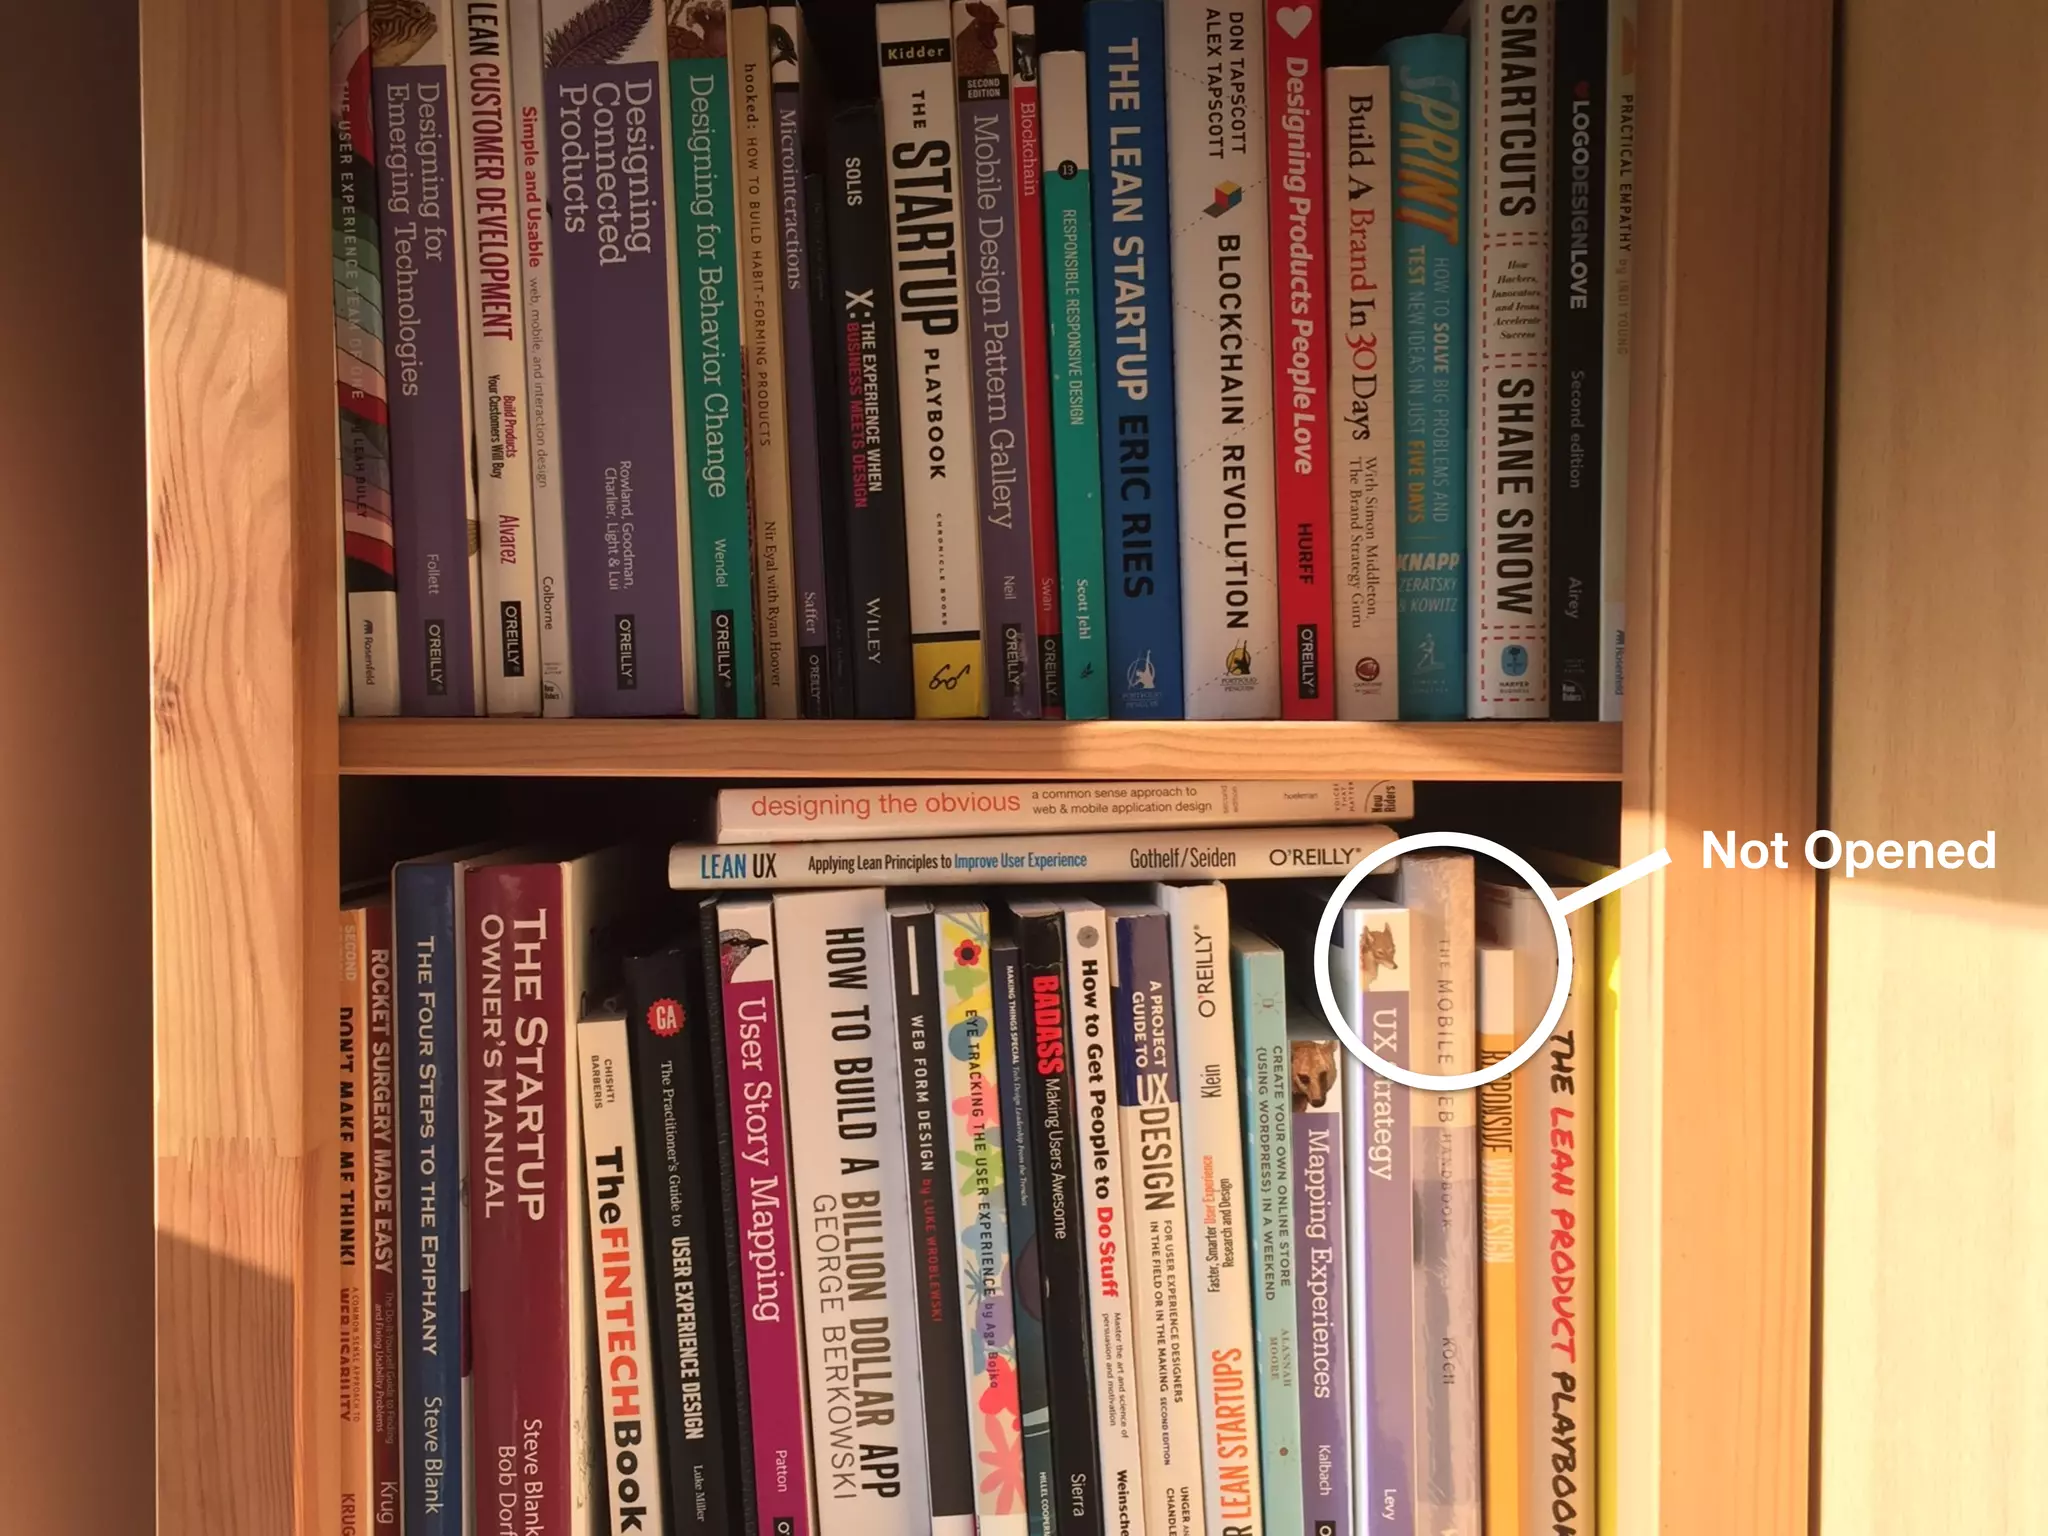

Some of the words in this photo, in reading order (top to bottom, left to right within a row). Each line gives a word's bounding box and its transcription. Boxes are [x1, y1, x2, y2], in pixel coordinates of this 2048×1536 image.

[468, 3, 499, 56] LEAN
[745, 64, 758, 130] hooked:
[967, 80, 999, 88] SECOND
[968, 90, 1000, 98] EDITION
[1108, 38, 1140, 111] THE
[469, 63, 503, 179] CUSTOMER
[521, 107, 537, 166] Simple
[1282, 57, 1311, 192] Designing
[1348, 95, 1374, 168] Build
[1499, 4, 1536, 216] SMARTCUTS
[386, 83, 411, 213] Emerging
[416, 83, 444, 218] Designing
[559, 84, 590, 233] Products
[592, 82, 626, 266] Connected
[622, 79, 656, 253] Designing
[688, 74, 719, 216] Designing
[747, 138, 759, 169] HOW
[973, 115, 1000, 210] Mobile
[1020, 103, 1037, 196] Blockchain
[1110, 127, 1144, 222] LEAN
[1395, 65, 1459, 245] SPRINT
[524, 172, 539, 202] and
[748, 177, 760, 194] TO
[780, 109, 804, 290] Microinteractions
[845, 158, 862, 207] SOLIS
[1349, 176, 1374, 200] A
[425, 227, 446, 261] for
[526, 207, 542, 267] Usable
[697, 224, 723, 259] for
[749, 202, 762, 244] BUILD
[1063, 210, 1078, 295] RESPONSIBLE
[1350, 209, 1377, 291] Brand
[476, 188, 512, 341] DEVELOPMENT
[976, 217, 1005, 315] Design
[1289, 197, 1313, 313] Products
[394, 222, 422, 396] Technologies
[699, 267, 726, 385] Behavior
[752, 251, 767, 366] HABIT-FORMING
[1066, 299, 1081, 376] RESPONSIVE
[1113, 235, 1148, 400] STARTUP
[1218, 235, 1243, 424] BLOCKCHAIN
[1350, 298, 1375, 328] In
[984, 322, 1010, 423] Pattern
[1286, 319, 1316, 408] People
[1345, 333, 1378, 370] 30
[756, 373, 770, 446] PRODUCTS
[1069, 381, 1084, 424] DESIGN
[1344, 374, 1377, 440] Days
[702, 394, 729, 498] Change
[1119, 415, 1151, 501] ERIC
[1294, 413, 1315, 474] Love
[1497, 378, 1534, 495] SHANE
[989, 429, 1016, 529] Gallery
[500, 515, 520, 564] Alvarez
[714, 539, 727, 587] Wendel
[1122, 513, 1154, 598] RIES
[1222, 445, 1248, 629] REVOLUTION
[1298, 523, 1314, 585] HURFF
[1496, 509, 1533, 614] SNOW
[426, 554, 440, 594] Follett
[542, 576, 554, 630] Colborne
[1566, 577, 1581, 618] Airey
[804, 592, 817, 633] Saffer
[866, 598, 880, 664] WILEY
[752, 795, 870, 821] designing
[879, 794, 917, 814] the
[925, 793, 1020, 813] obvious
[1033, 805, 1057, 815] web
[1060, 804, 1068, 813] &
[1072, 803, 1107, 813] mobile
[1111, 802, 1168, 815] application
[1175, 802, 1211, 813] design
[1284, 792, 1318, 800] hoekman
[1372, 795, 1381, 812] New
[1385, 786, 1395, 812] Riders
[701, 854, 746, 879] LEAN
[753, 853, 777, 879] UX
[826, 927, 868, 989] HOW
[1006, 965, 1015, 999] MAKING
[1150, 981, 1161, 991] A
[372, 949, 389, 1035] ROCKET
[1008, 1001, 1017, 1030] THINGS
[1132, 991, 1145, 1041] GUIDE
[738, 997, 766, 1071] User
[831, 1005, 871, 1041] TO
[911, 1015, 925, 1050] WEB
[1010, 1032, 1020, 1064] SPECIAL
[1032, 976, 1064, 1075] BADASS
[1151, 995, 1166, 1067] PROJECT
[591, 1055, 603, 1109] BARBERIS
[604, 1059, 614, 1102] CHISHTI
[913, 1058, 928, 1102] FORM
[1135, 1045, 1147, 1067] TO
[1200, 1064, 1221, 1098] Klein
[1273, 1046, 1284, 1098] CREATE
[1550, 1030, 1574, 1095] THE
[372, 1043, 391, 1140] SURGERY
[834, 1057, 877, 1140] BUILD
[1045, 1079, 1061, 1127] Making
[745, 1081, 773, 1166] Story
[917, 1111, 933, 1171] DESIGN
[1048, 1130, 1064, 1170] Users
[1275, 1103, 1286, 1141] YOUR
[1551, 1107, 1574, 1196] LEAN
[374, 1149, 392, 1212] MADE
[841, 1158, 879, 1175] A
[921, 1179, 932, 1195] by
[1276, 1146, 1287, 1180] OWN
[1304, 1130, 1331, 1240] Mapping
[924, 1200, 935, 1232] LUKE
[1051, 1173, 1068, 1239] Awesome
[1219, 1179, 1230, 1208] Design
[1222, 1210, 1231, 1225] and
[1277, 1186, 1289, 1237] ONLINE
[374, 1219, 392, 1273] EASY
[671, 1236, 692, 1277] USER
[747, 1176, 785, 1322] Mapping
[813, 1195, 844, 1314] GEORGE
[841, 1191, 887, 1301] BILLION
[1164, 1220, 1175, 1242] FOR
[1165, 1244, 1177, 1271] USER
[1222, 1228, 1234, 1268] Research
[925, 1236, 942, 1322] WROBLEWSKI
[1279, 1242, 1291, 1287] STORE
[1551, 1209, 1575, 1363] PRODUCT
[674, 1282, 699, 1378] EXPERIENCE
[1167, 1274, 1180, 1340] EXPERIENCE
[1305, 1247, 1333, 1398] Experiences
[849, 1317, 895, 1427] DOLLAR
[1171, 1342, 1183, 1403] DESIGNERS
[1270, 1337, 1279, 1380] MOORE
[1442, 1337, 1455, 1384] KOCH
[424, 1397, 442, 1451] Steve
[682, 1383, 704, 1439] DESIGN
[822, 1327, 856, 1499] BERKOWSKI
[1212, 1348, 1248, 1459] STARTUPS
[524, 1419, 543, 1474] Steve
[775, 1449, 789, 1492] Patton
[859, 1444, 901, 1499] APP
[1318, 1444, 1332, 1495] Kalbach
[1551, 1372, 1577, 1536] PLAYBOOK
[377, 1482, 398, 1524] Krug
[425, 1459, 444, 1514] Blank
[693, 1465, 704, 1489] Luke
[695, 1492, 706, 1521] Miller
[1219, 1466, 1252, 1519] LEAN
[1382, 1488, 1397, 1520] Levy
[524, 1482, 543, 1536] Blank
